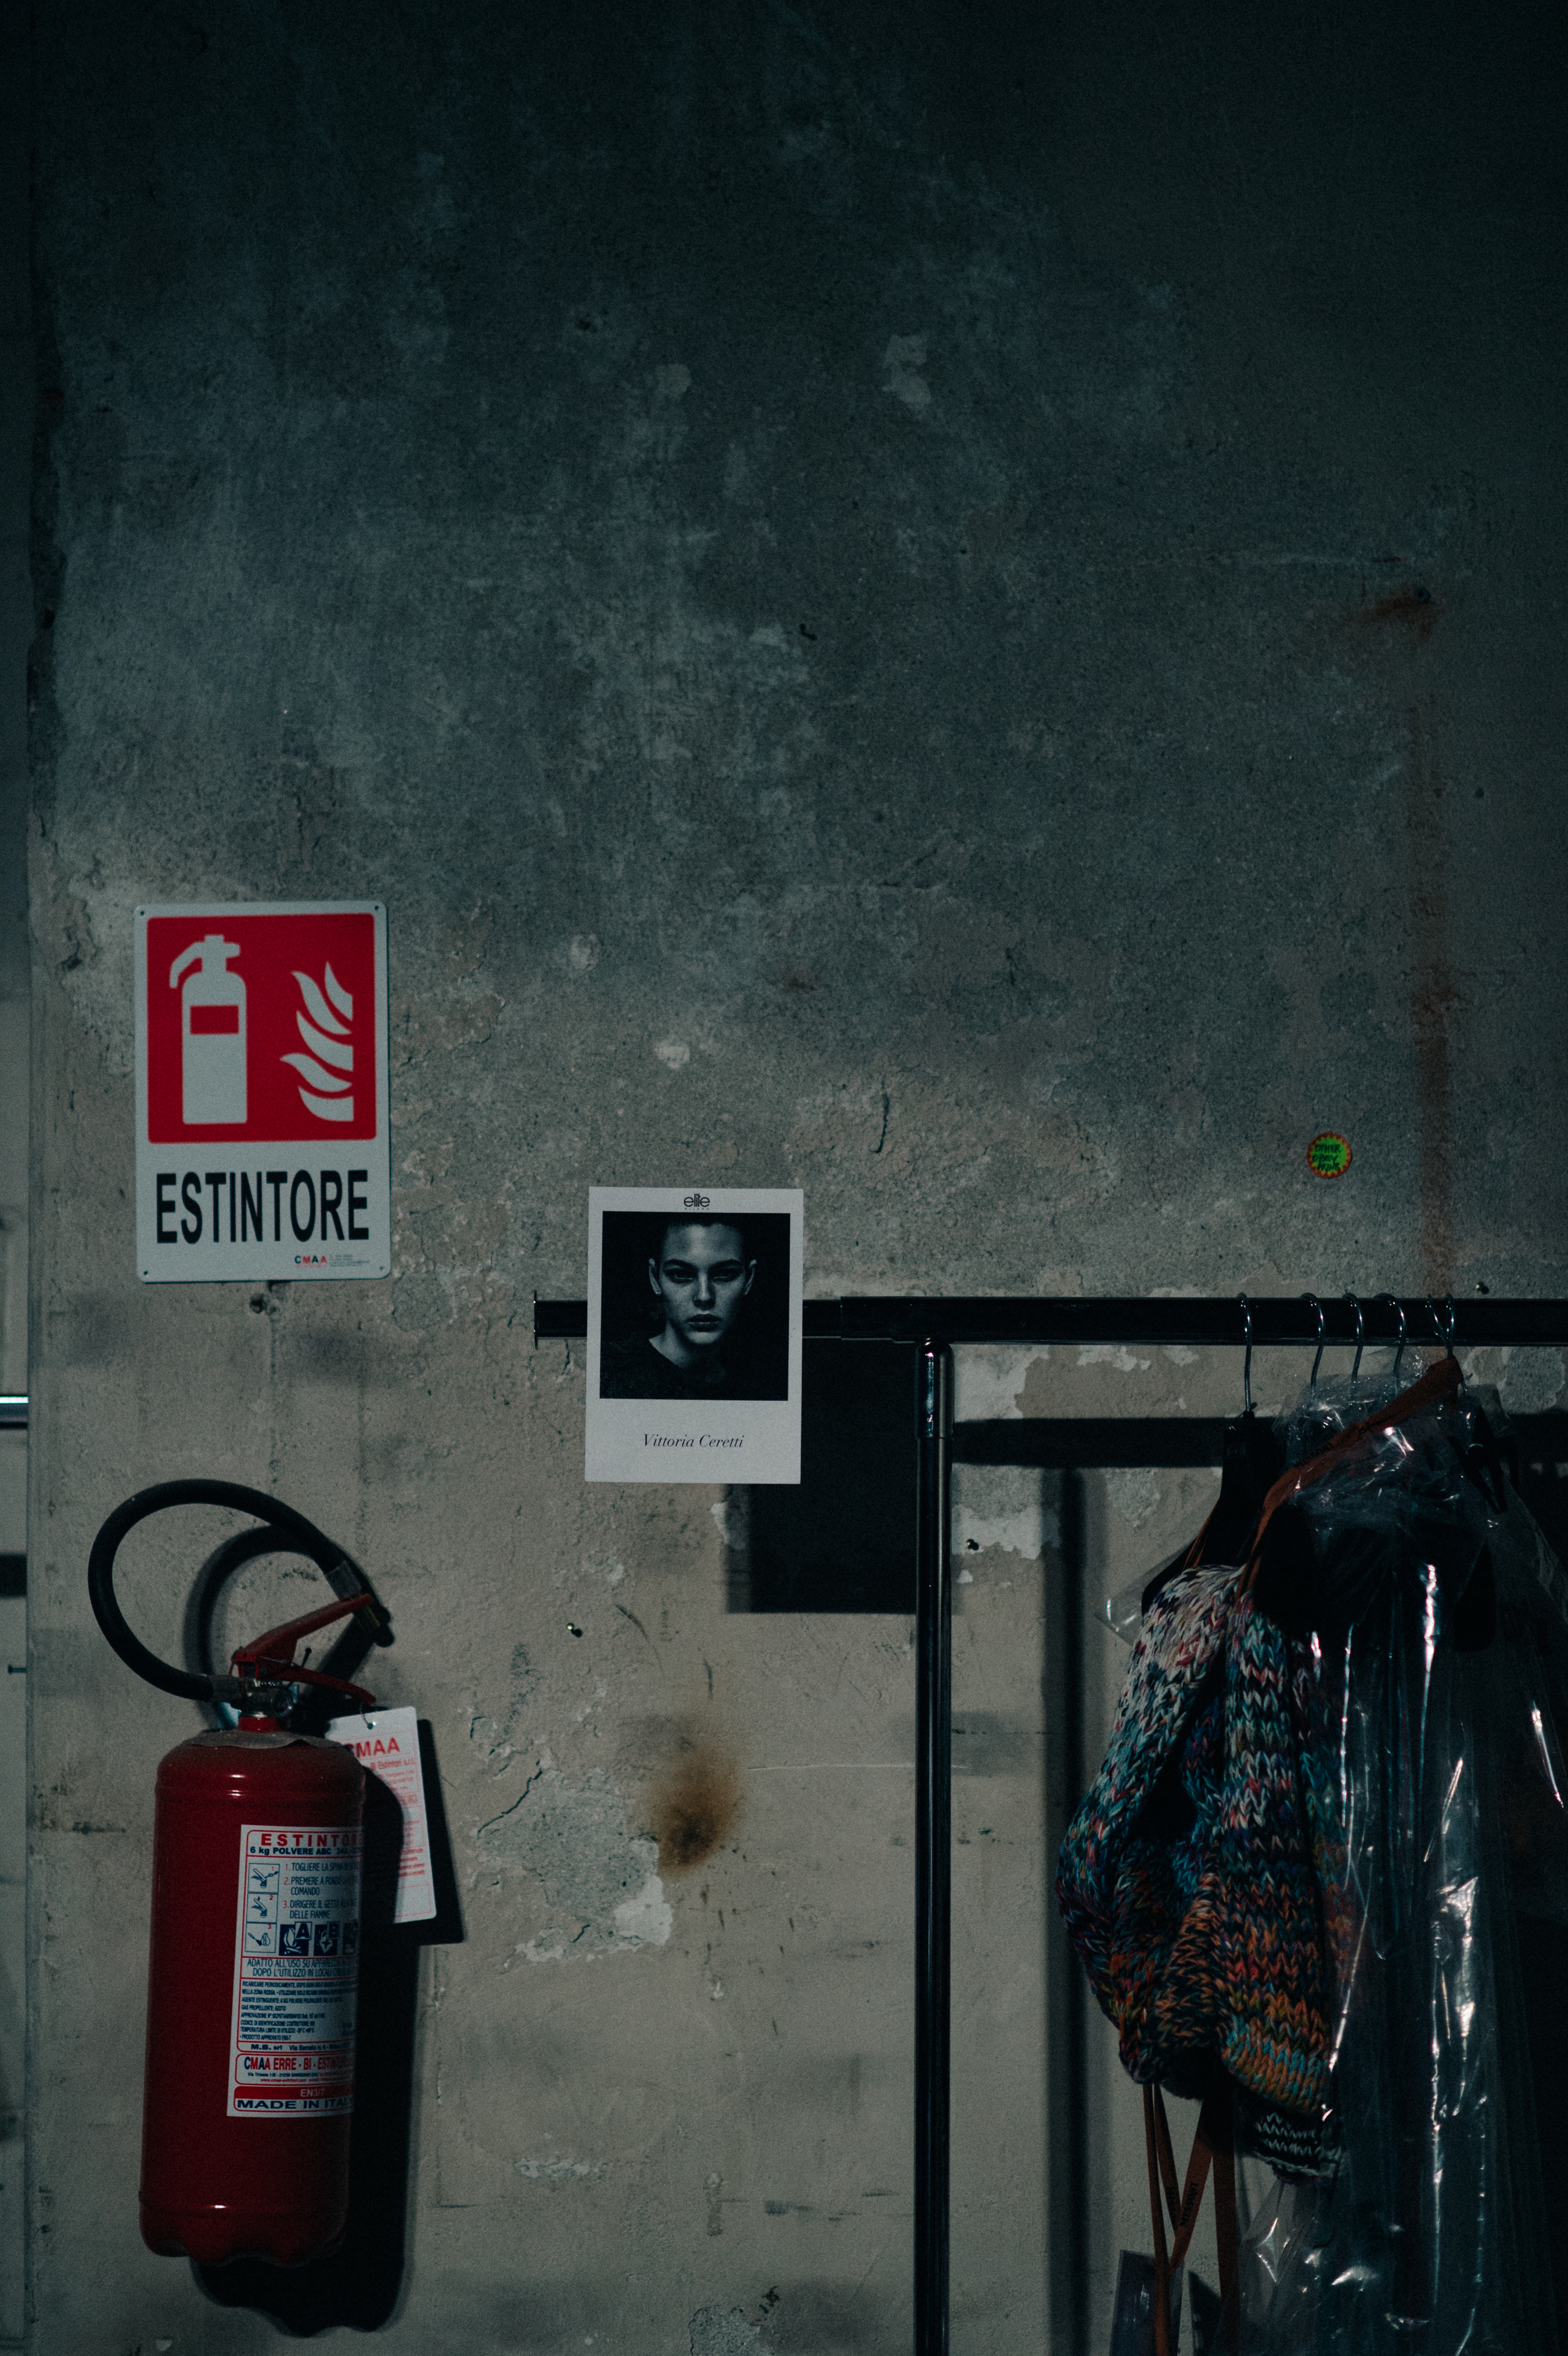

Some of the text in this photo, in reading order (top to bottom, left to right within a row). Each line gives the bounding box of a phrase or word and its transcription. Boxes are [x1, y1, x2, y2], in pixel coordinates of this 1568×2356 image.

[684, 1193, 710, 1207] elite
[157, 1170, 369, 1244] ESTINTORE
[294, 1255, 328, 1264] CMAA
[644, 1434, 745, 1448] Vittoria Ceretti
[346, 1738, 401, 1757] MAA
[261, 1833, 359, 1847] ESTINTOR
[259, 1847, 269, 1855] kg
[292, 1862, 320, 1871] TOGLIERE
[321, 1863, 329, 1871] LA
[291, 1876, 319, 1885] PREMERE
[291, 1887, 320, 1895] COMANDO
[290, 1900, 317, 1908] DIRIGERE
[290, 1910, 330, 1919] DELLE FIAMME
[296, 1923, 310, 1938] A
[328, 1923, 339, 1938] B
[247, 1958, 273, 1967] ADATTO
[275, 1959, 301, 1967] ALL'USO
[303, 1959, 310, 1967] SU
[253, 1967, 271, 1976] DOPO
[274, 1968, 306, 1977] L'UTILIZZO
[244, 2056, 271, 2070] CMAA
[274, 2058, 297, 2070] ERRE
[303, 2058, 311, 2070] BI
[300, 2088, 325, 2097] EN3/7
[238, 2099, 296, 2109] MADE
[304, 2100, 319, 2109] IN
